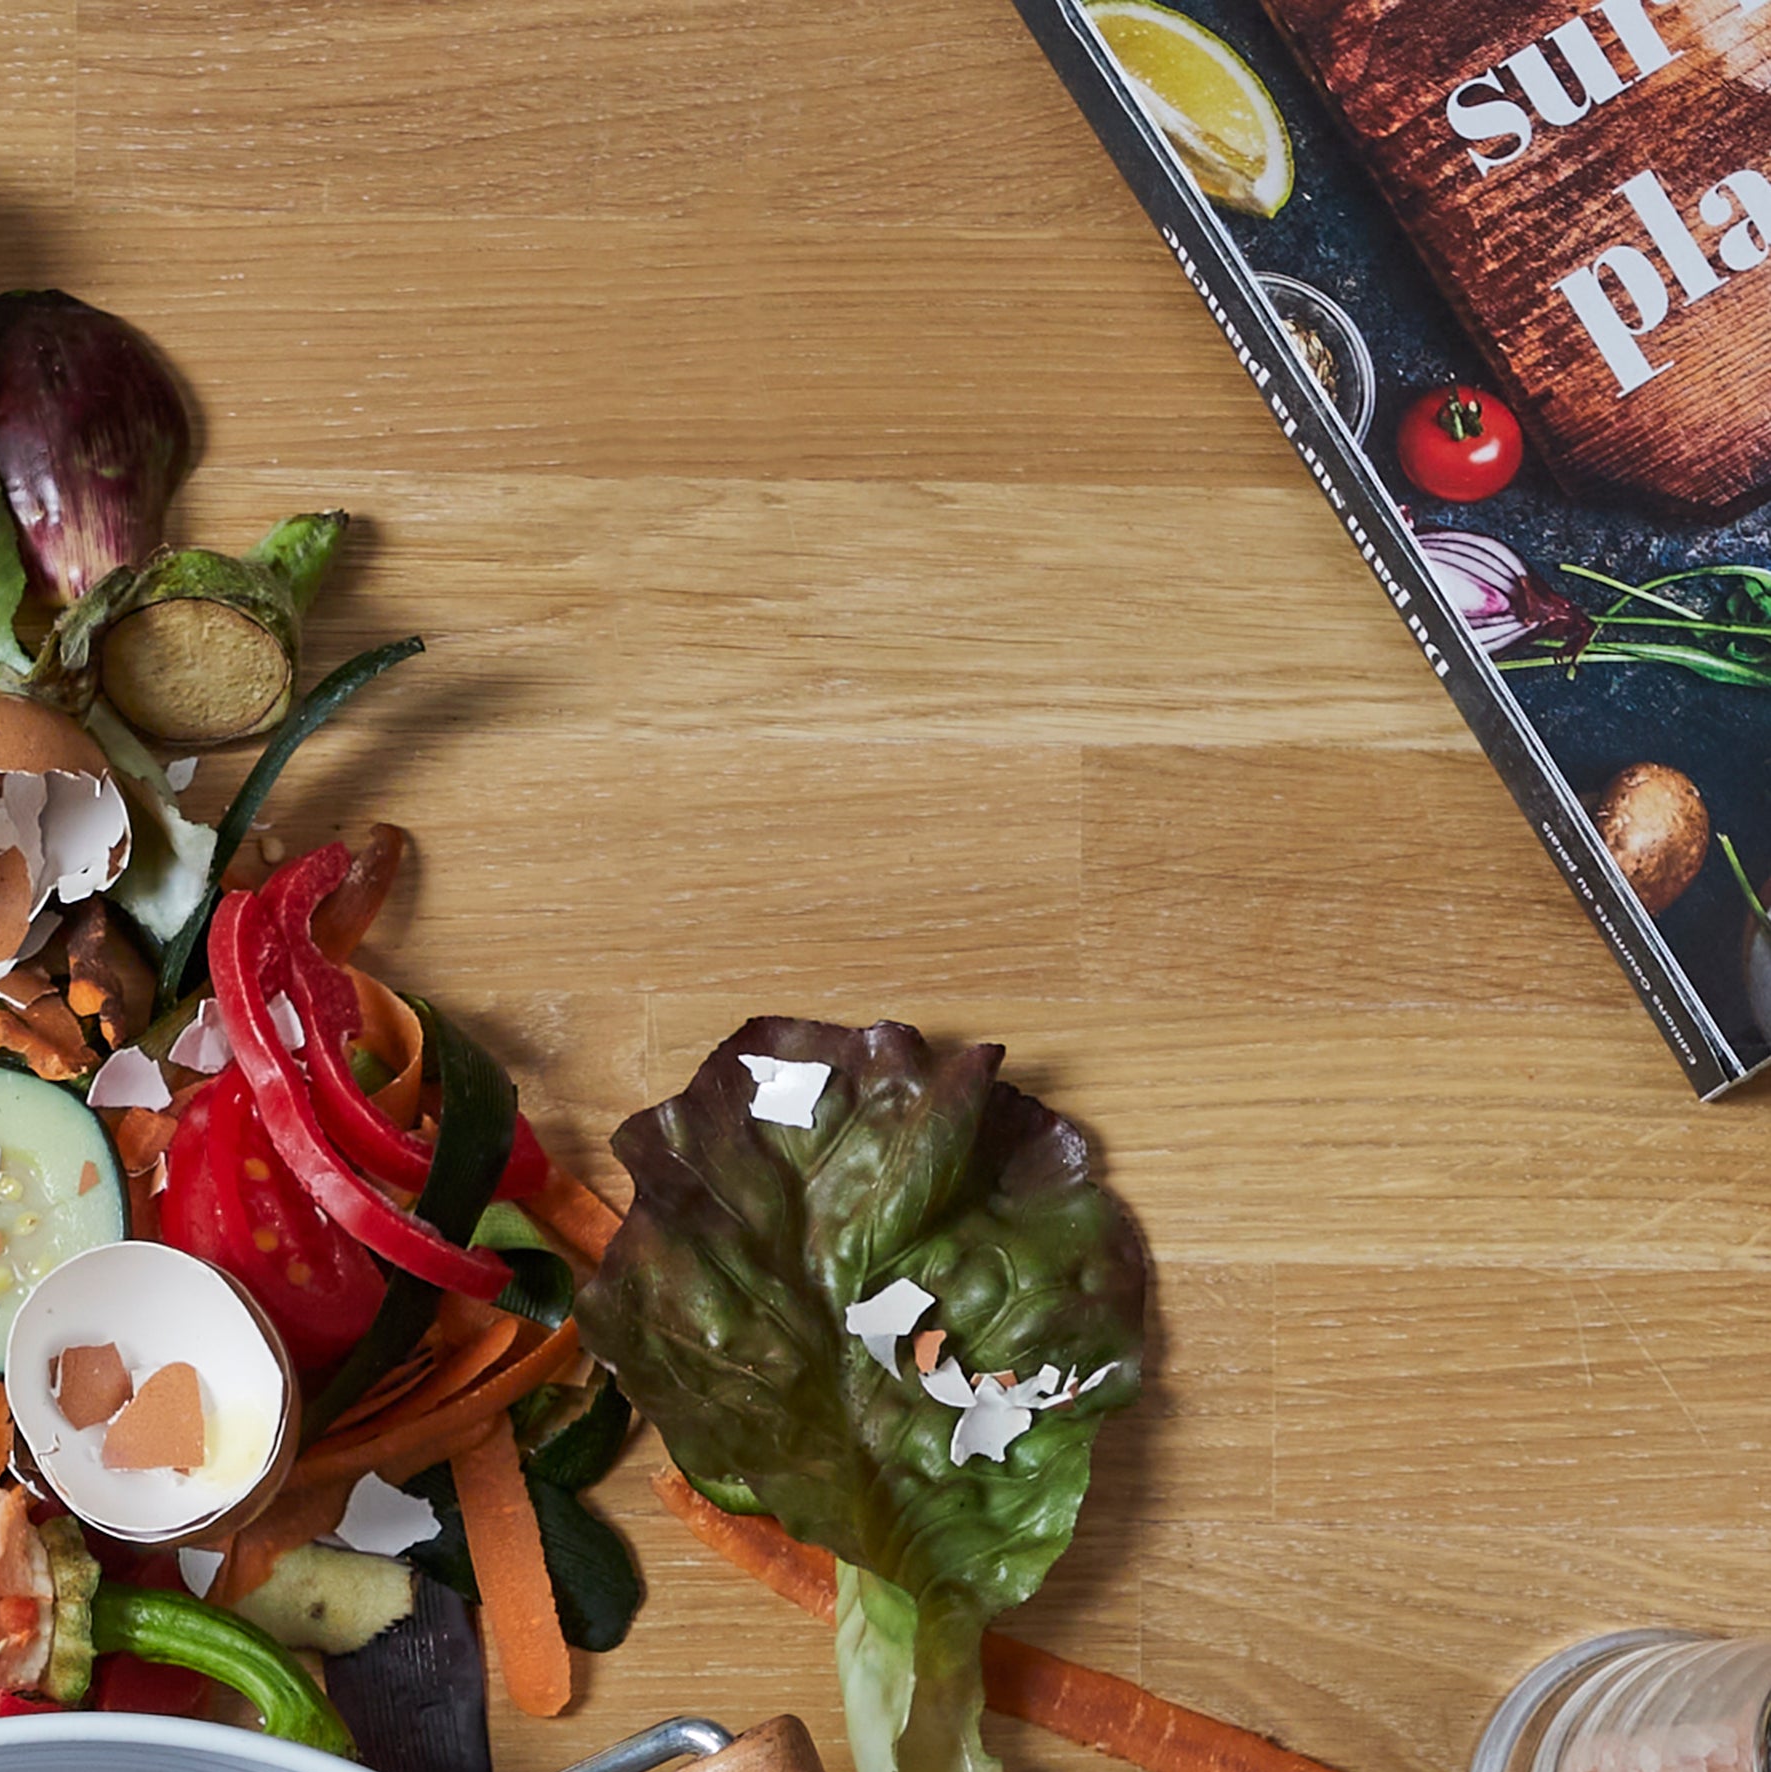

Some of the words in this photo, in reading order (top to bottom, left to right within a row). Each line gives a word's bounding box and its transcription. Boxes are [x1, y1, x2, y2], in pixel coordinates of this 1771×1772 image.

[1446, 0, 1685, 178] sur
[1162, 223, 1271, 388] planche
[1550, 169, 1771, 399] pla
[1271, 392, 1298, 438] la
[1297, 441, 1346, 510] sur
[1346, 514, 1412, 609] pain
[1408, 613, 1450, 678] Du
[1541, 820, 1579, 874] palais
[1576, 876, 1595, 901] du
[1594, 903, 1652, 992] Gourmets
[1652, 994, 1697, 1066] Editions
